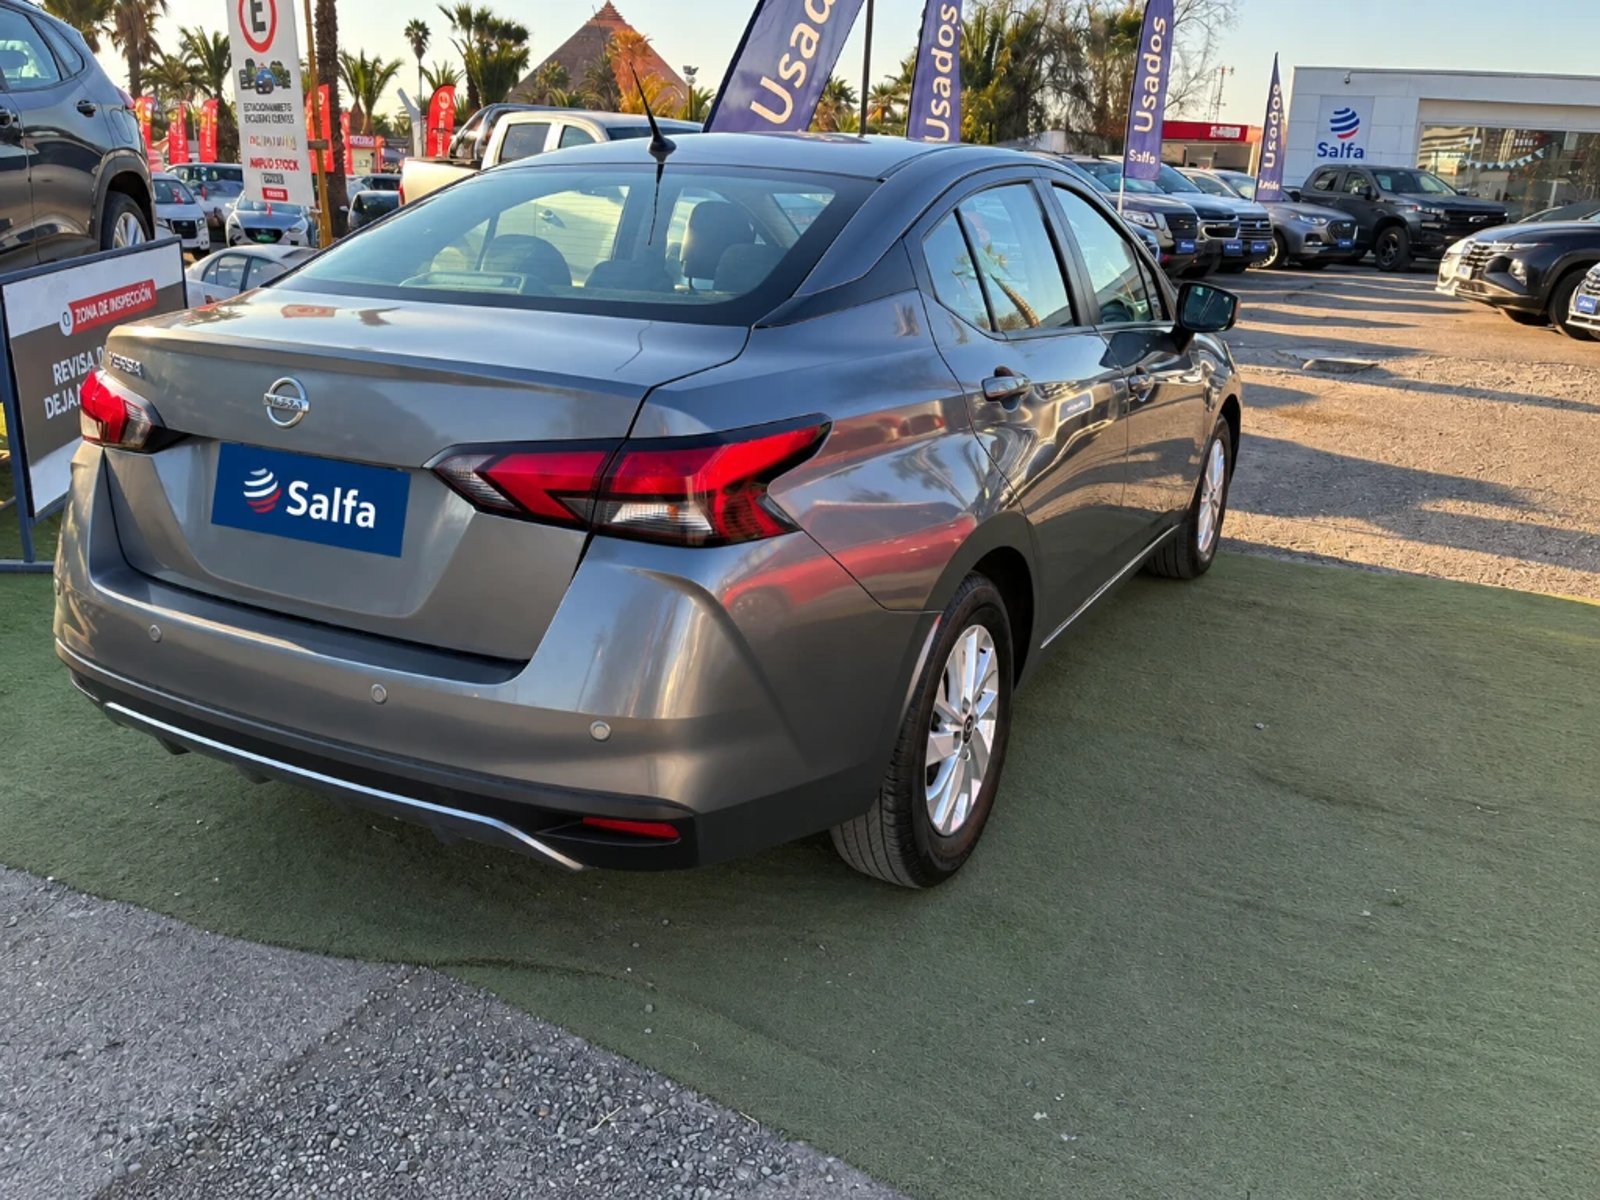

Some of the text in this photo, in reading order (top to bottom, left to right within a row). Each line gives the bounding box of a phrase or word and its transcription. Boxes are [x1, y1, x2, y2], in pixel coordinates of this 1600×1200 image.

[924, 4, 958, 142] Usados
[1134, 16, 1167, 132] Usados
[1317, 142, 1365, 159] Salfa
[75, 306, 98, 324] ZONA
[98, 299, 109, 317] DE
[53, 350, 96, 386] REVISA
[44, 388, 75, 419] DEJA
[286, 480, 376, 529] Salfa
